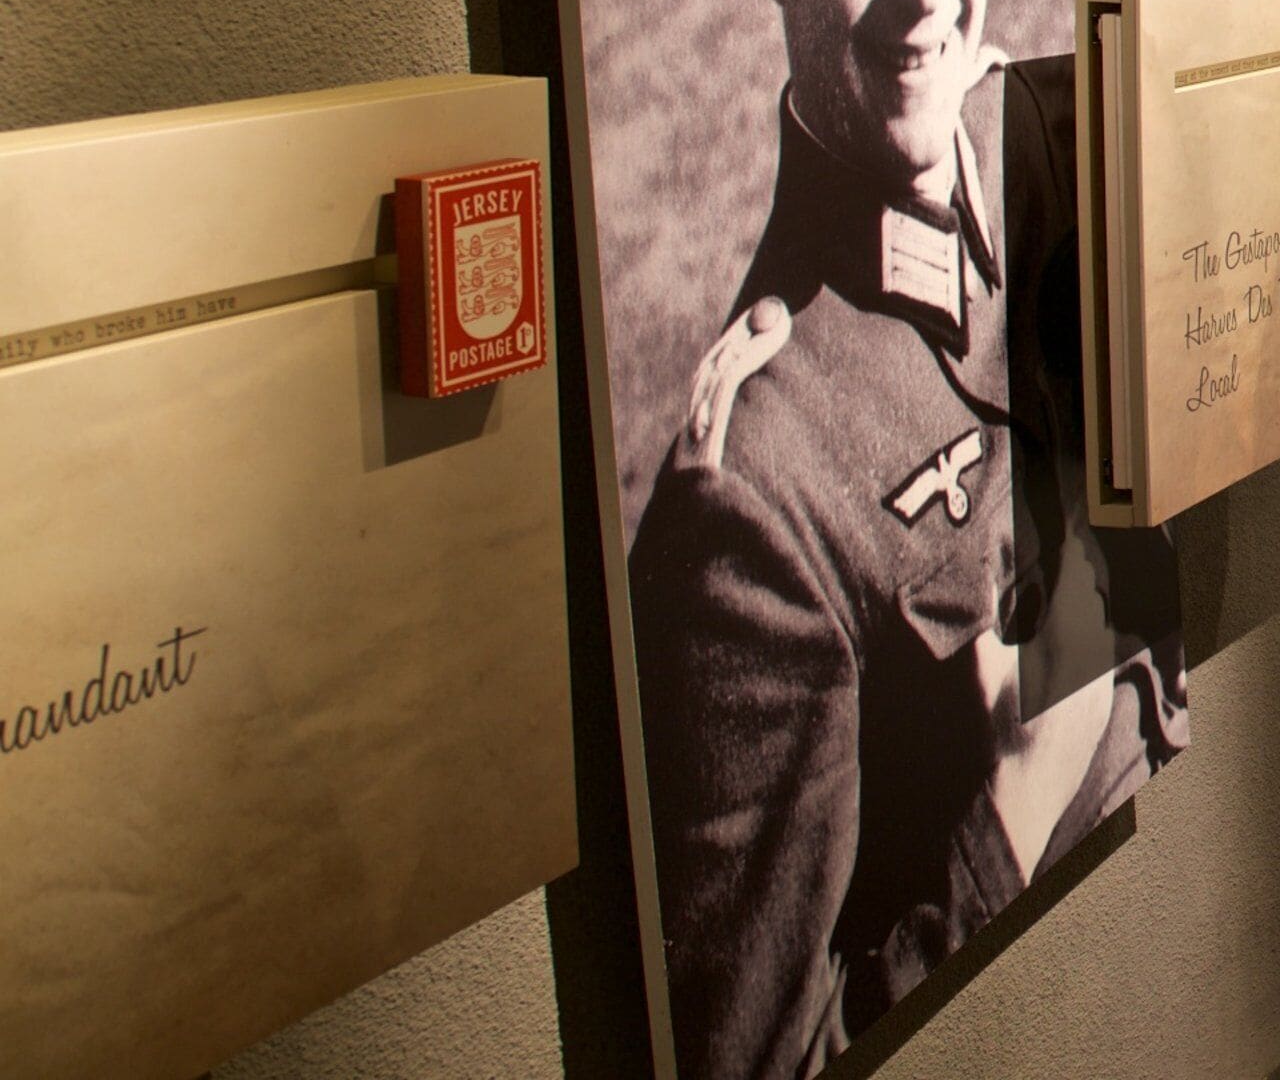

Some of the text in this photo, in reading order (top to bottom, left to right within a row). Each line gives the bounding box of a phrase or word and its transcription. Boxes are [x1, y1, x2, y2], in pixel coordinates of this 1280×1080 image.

[453, 189, 523, 227] JERSEY
[1182, 240, 1221, 282] The
[1243, 284, 1273, 324] Des
[0, 295, 238, 357] ily who broke him have
[450, 336, 514, 371] POSTAGE
[1186, 354, 1241, 412] Local
